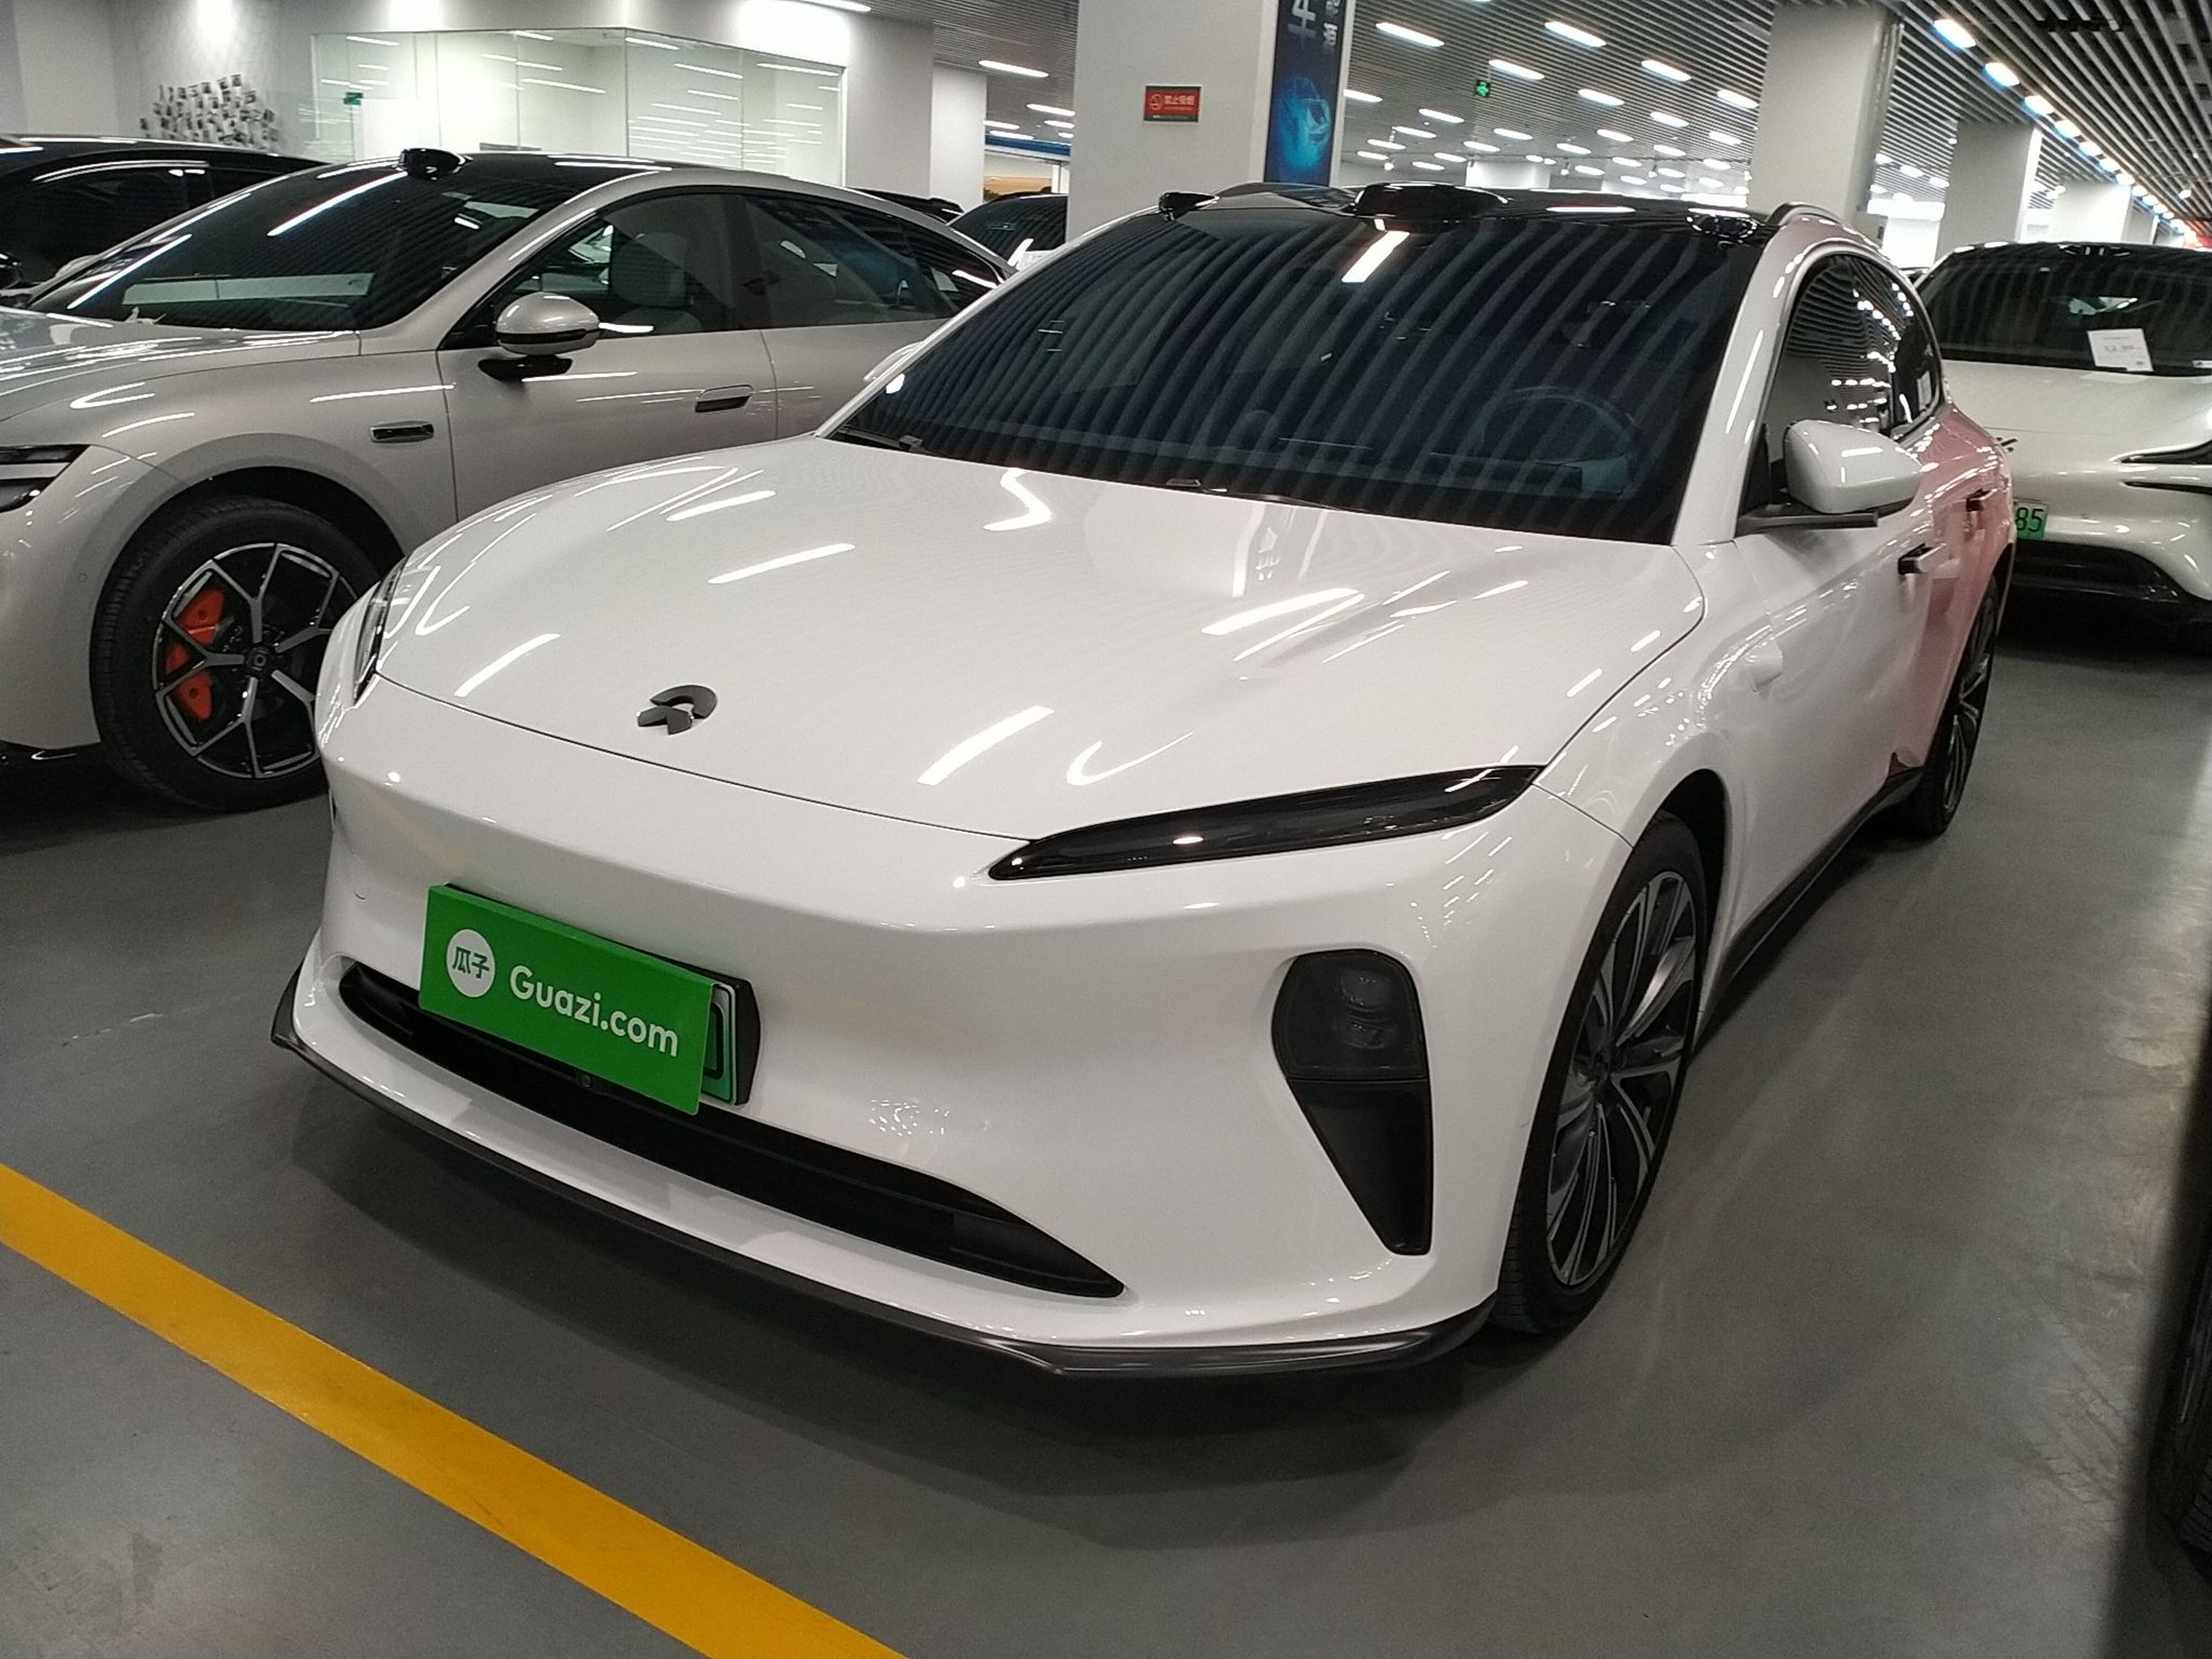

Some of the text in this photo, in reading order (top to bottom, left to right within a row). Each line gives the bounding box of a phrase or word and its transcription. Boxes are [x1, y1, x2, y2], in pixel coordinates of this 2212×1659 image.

[2015, 507, 2044, 532] 85
[452, 946, 490, 979] 瓜子
[510, 965, 679, 1057] Guazi.com
